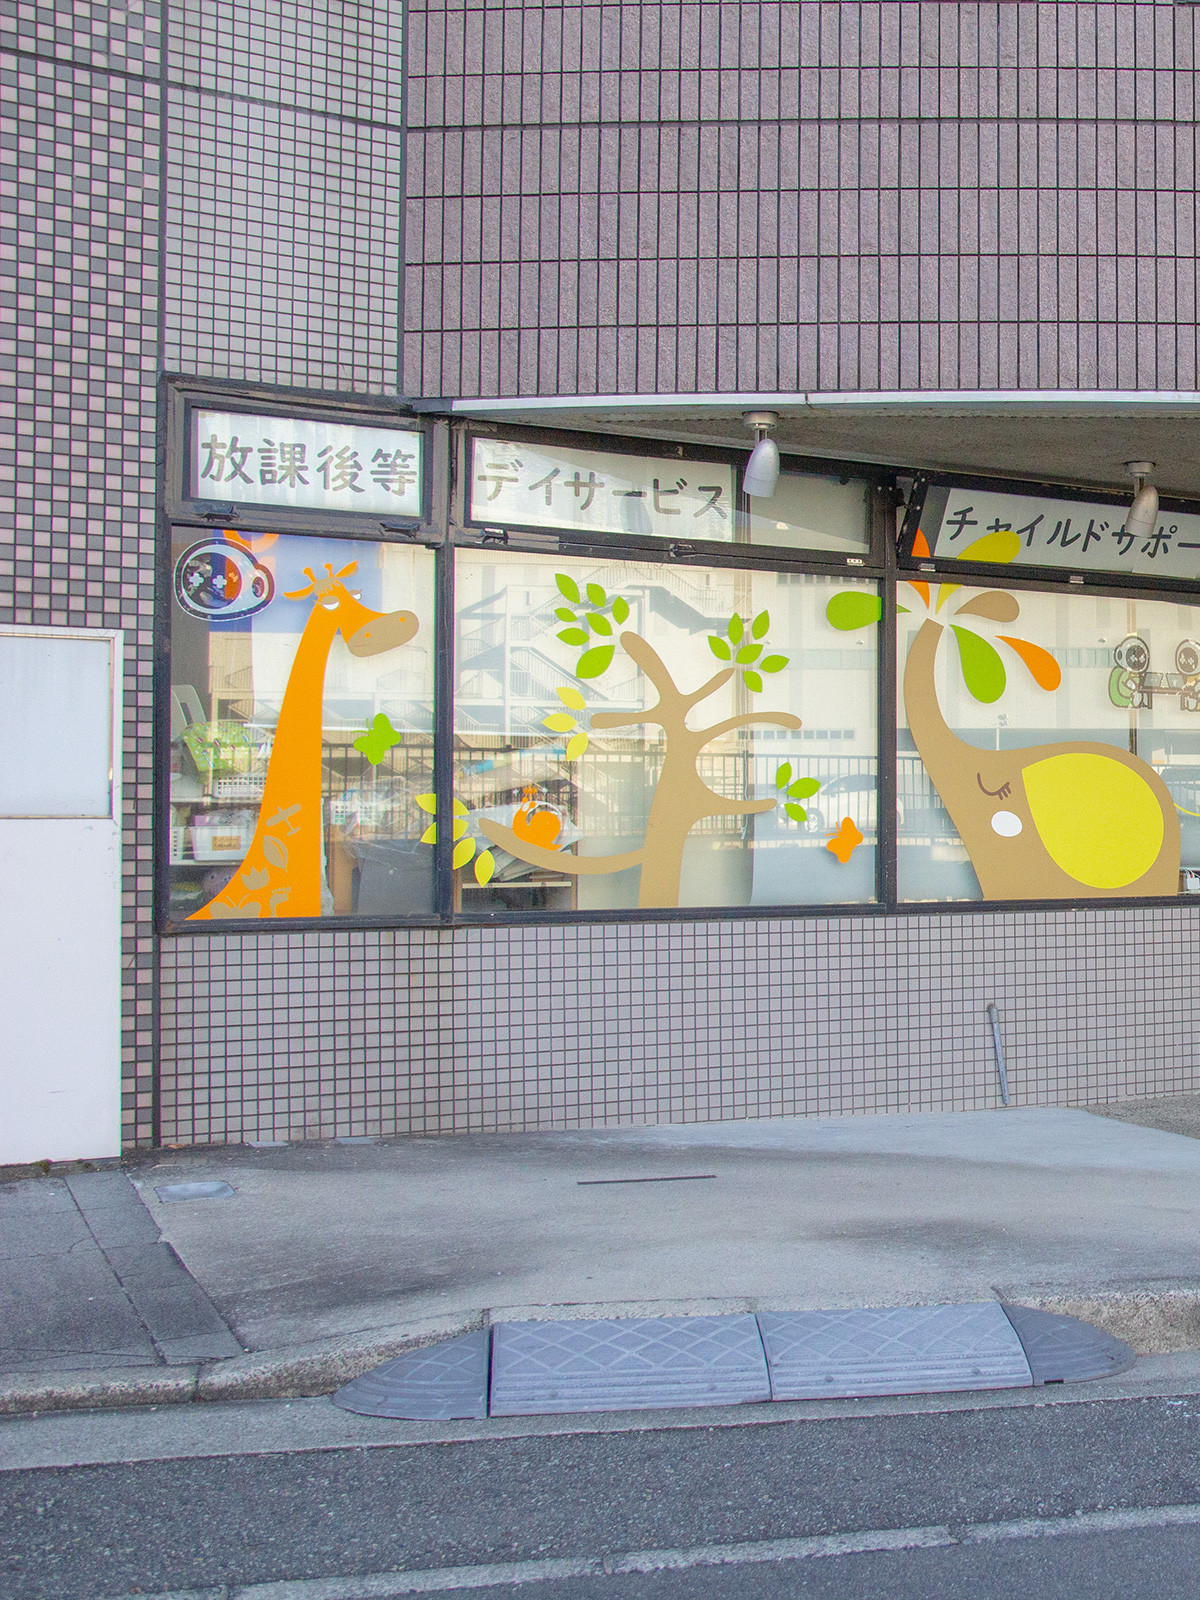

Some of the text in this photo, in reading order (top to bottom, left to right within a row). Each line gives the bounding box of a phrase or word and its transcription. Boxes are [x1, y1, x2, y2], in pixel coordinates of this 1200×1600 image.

[201, 433, 417, 496] 放課後等
[477, 458, 728, 519] デイサービス
